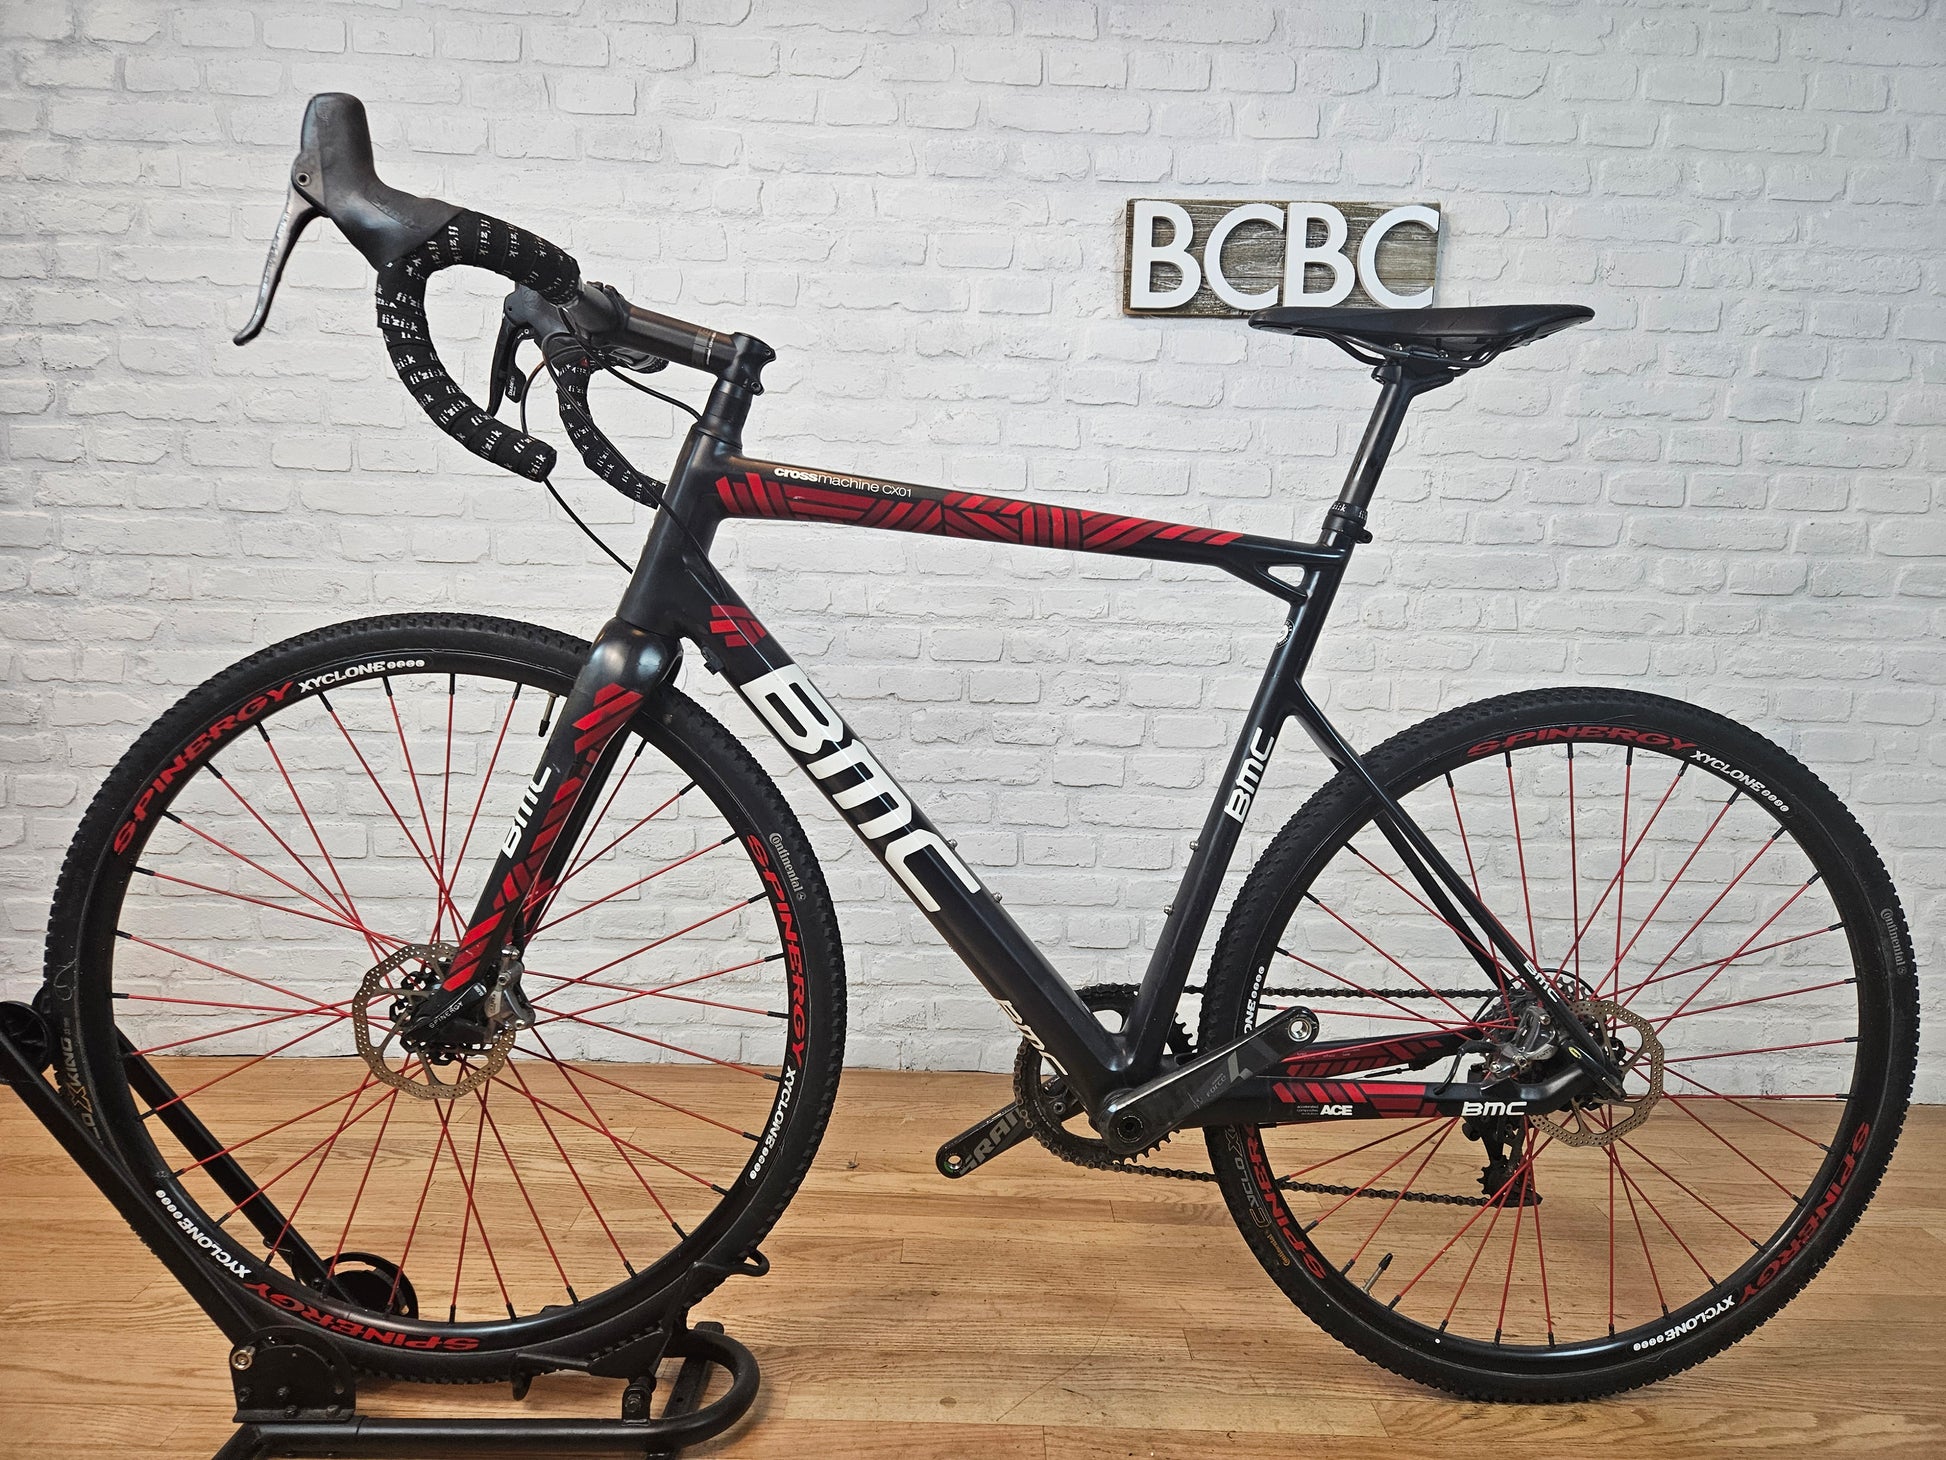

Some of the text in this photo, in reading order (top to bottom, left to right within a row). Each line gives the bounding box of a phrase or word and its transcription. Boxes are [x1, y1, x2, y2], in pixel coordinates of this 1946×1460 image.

[1130, 200, 1441, 309] BCBC
[774, 467, 912, 498] crossmachine CX01
[299, 660, 386, 693] XYCLONE
[113, 681, 294, 856] SPINERGY
[1467, 725, 1696, 758] SPINERGY
[1690, 750, 1765, 792] XYCLONE
[740, 664, 981, 912] BMC
[1223, 726, 1274, 824] BMC
[501, 766, 552, 859] BMC
[769, 832, 804, 892] Continental
[747, 833, 804, 1069] SPINERGY
[1880, 908, 1903, 967] Continental
[1524, 960, 1560, 1003] BMC
[429, 1002, 464, 1029] SPINERGY
[765, 1065, 798, 1147] XYCLONE
[1320, 1104, 1353, 1116] ACE
[1461, 1101, 1527, 1116] BMC
[1738, 1121, 1870, 1305] SPINERGY
[178, 1217, 251, 1279] XYCLONE
[244, 1281, 480, 1353] SPINERGY
[1664, 1294, 1735, 1342] XYCLONE
